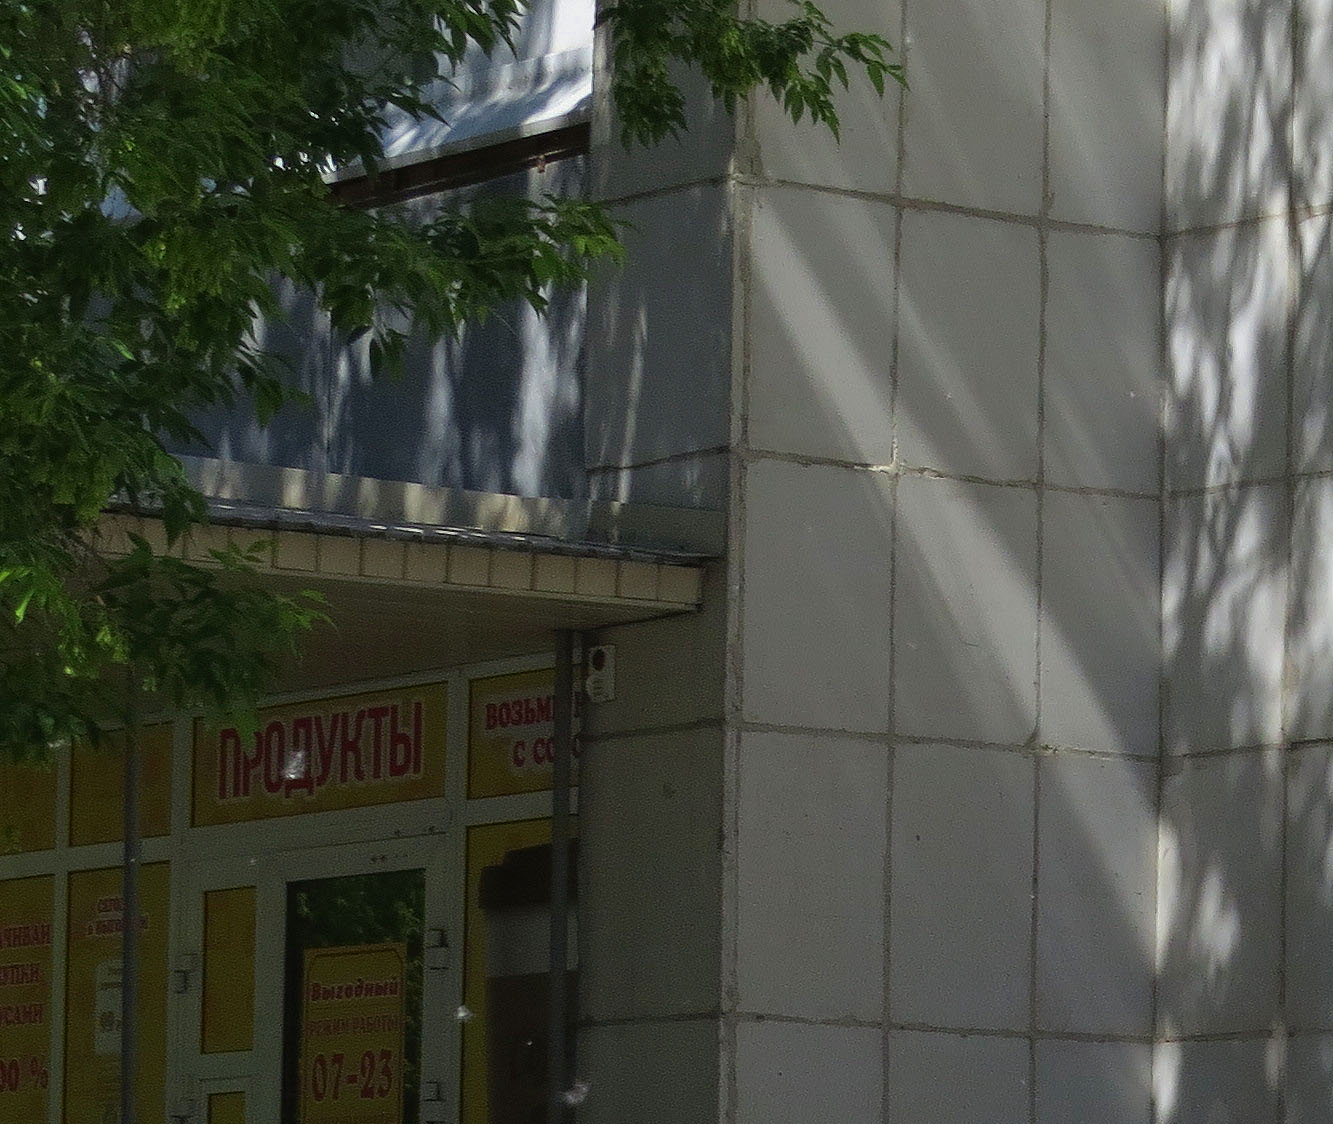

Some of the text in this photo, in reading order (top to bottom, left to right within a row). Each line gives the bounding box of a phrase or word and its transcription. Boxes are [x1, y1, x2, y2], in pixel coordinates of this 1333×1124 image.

[219, 701, 422, 799] ПРОДУКТЫ
[311, 977, 399, 1001] Выгодный
[312, 1048, 393, 1103] 07-23
